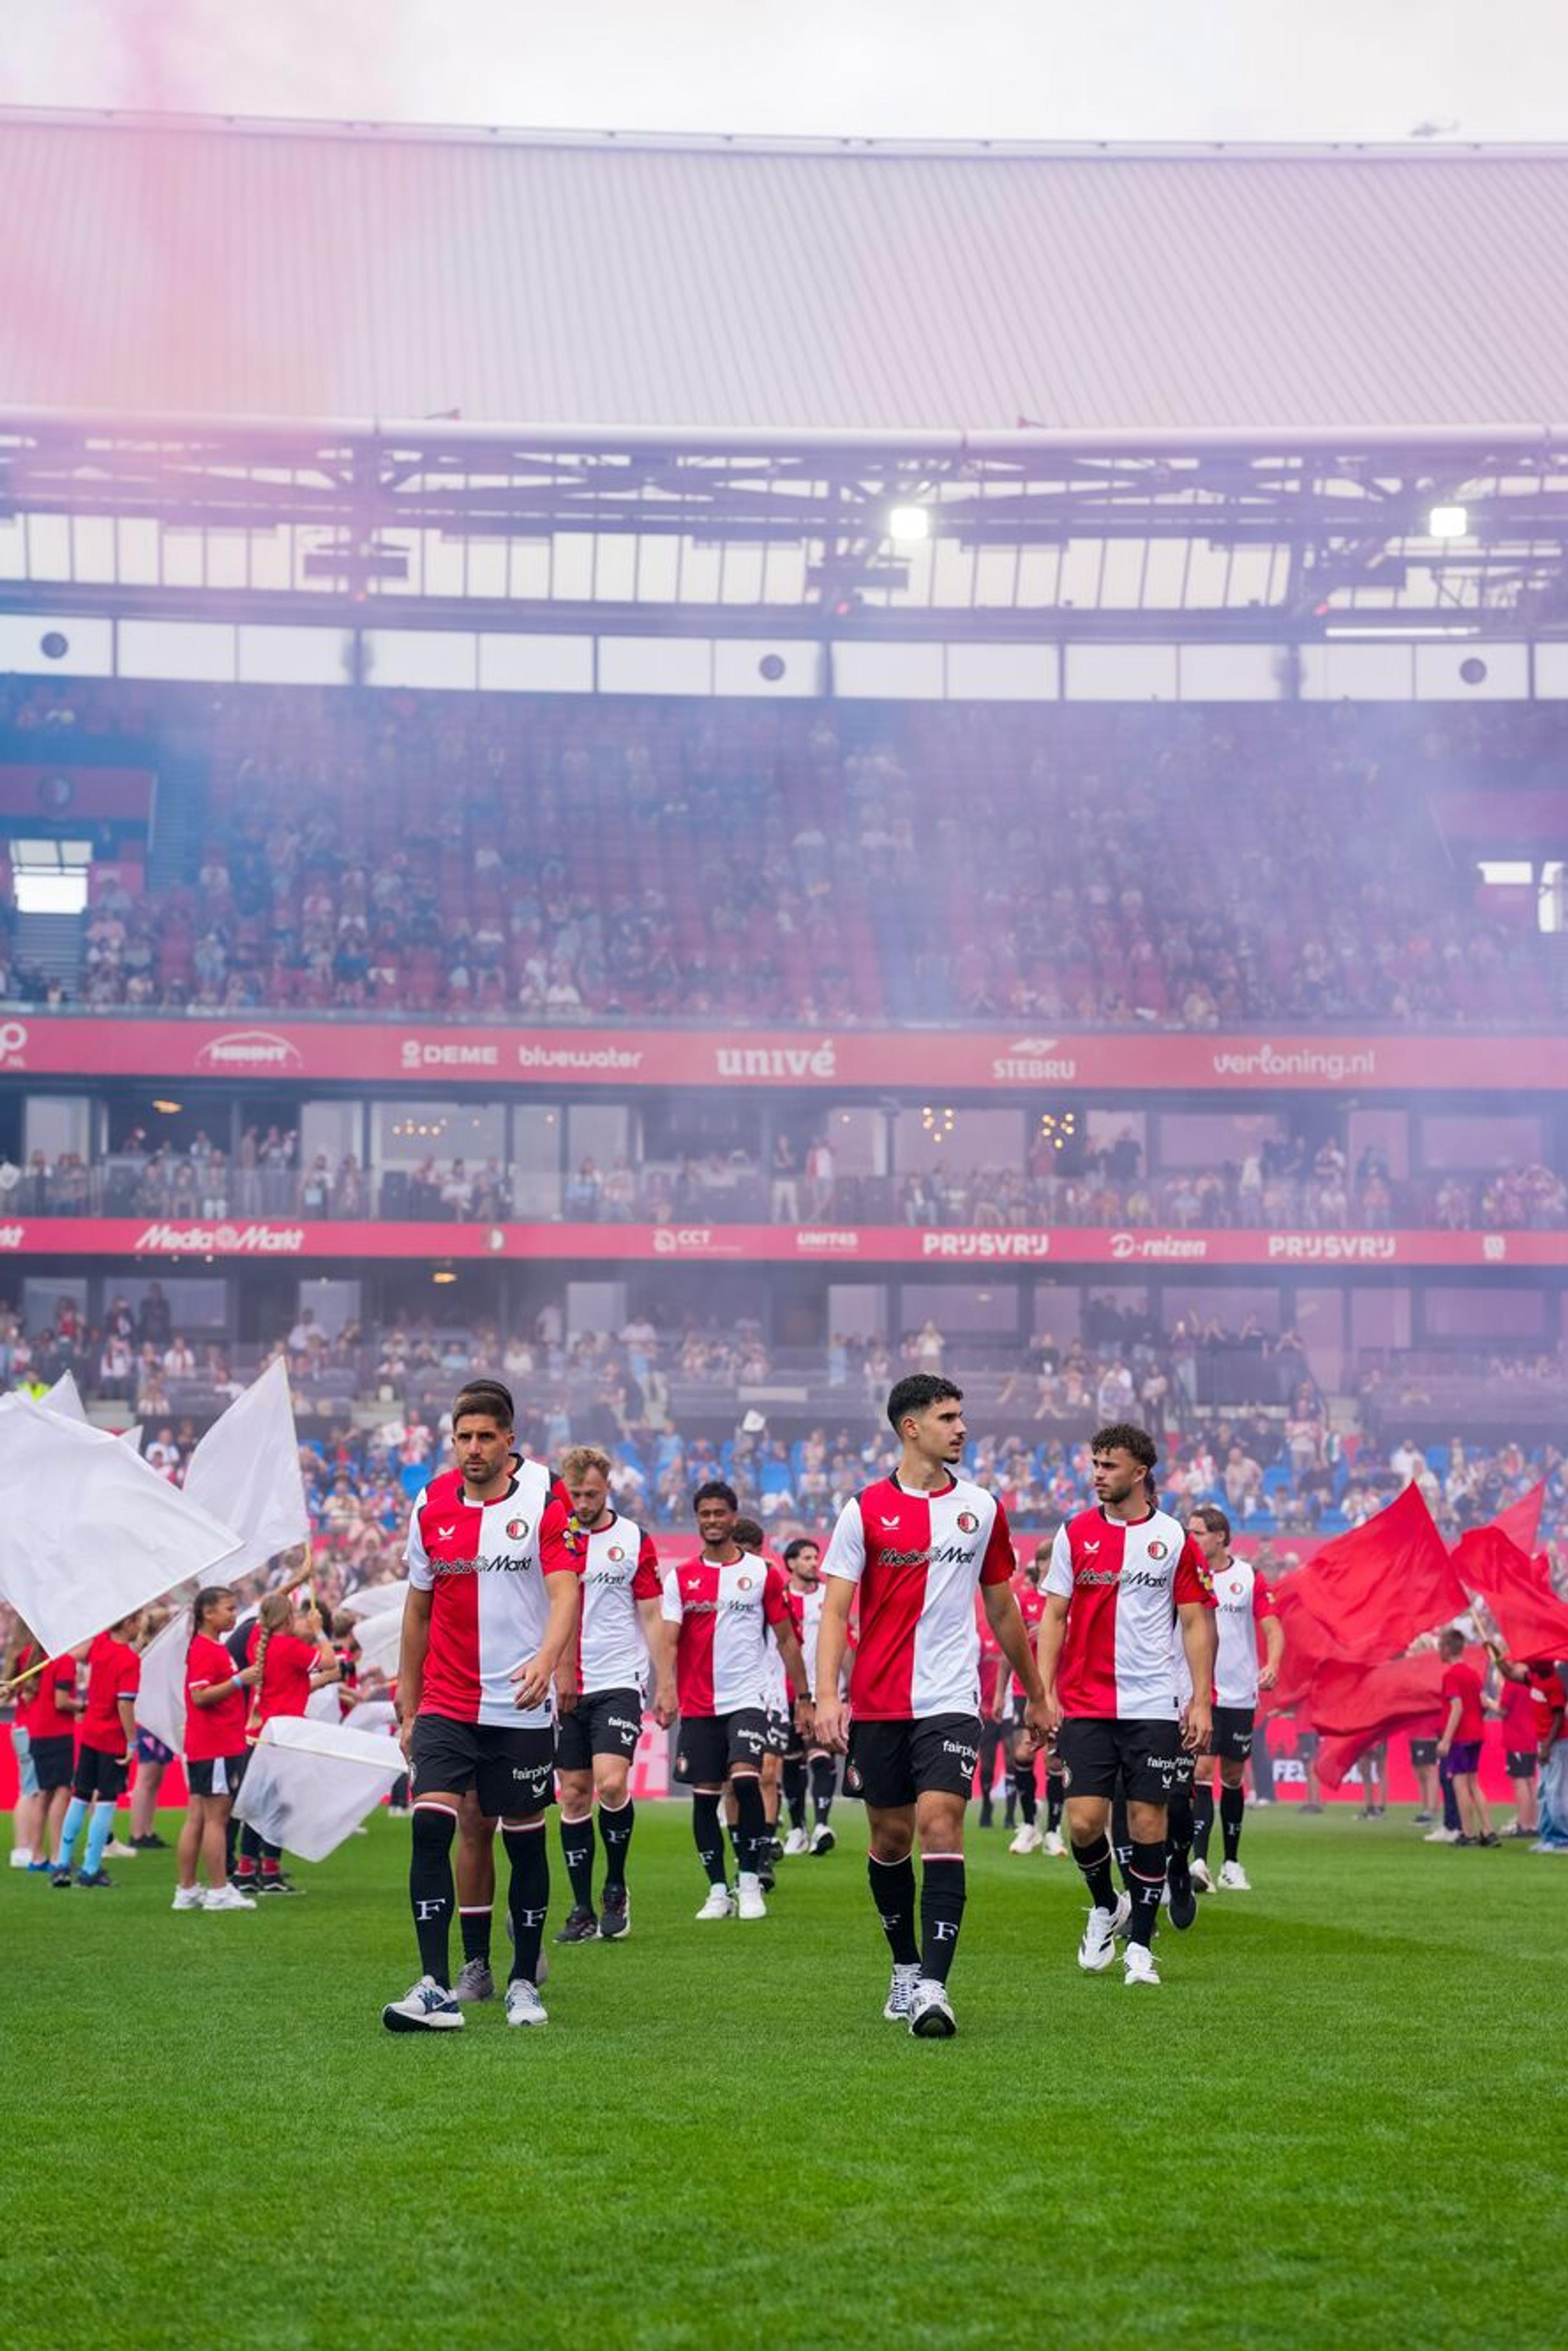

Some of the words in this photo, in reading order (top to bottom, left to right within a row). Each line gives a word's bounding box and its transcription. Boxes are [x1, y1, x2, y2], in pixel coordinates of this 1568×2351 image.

[424, 1044, 498, 1064] DEME
[518, 1044, 644, 1068] bluewater
[716, 1039, 836, 1077] univé
[992, 1059, 1075, 1080] STEBRU
[566, 1848, 587, 1867] F
[1139, 1886, 1162, 1905] F
[416, 1898, 445, 1921] F
[522, 1906, 547, 1927] F
[933, 1920, 959, 1941] F
